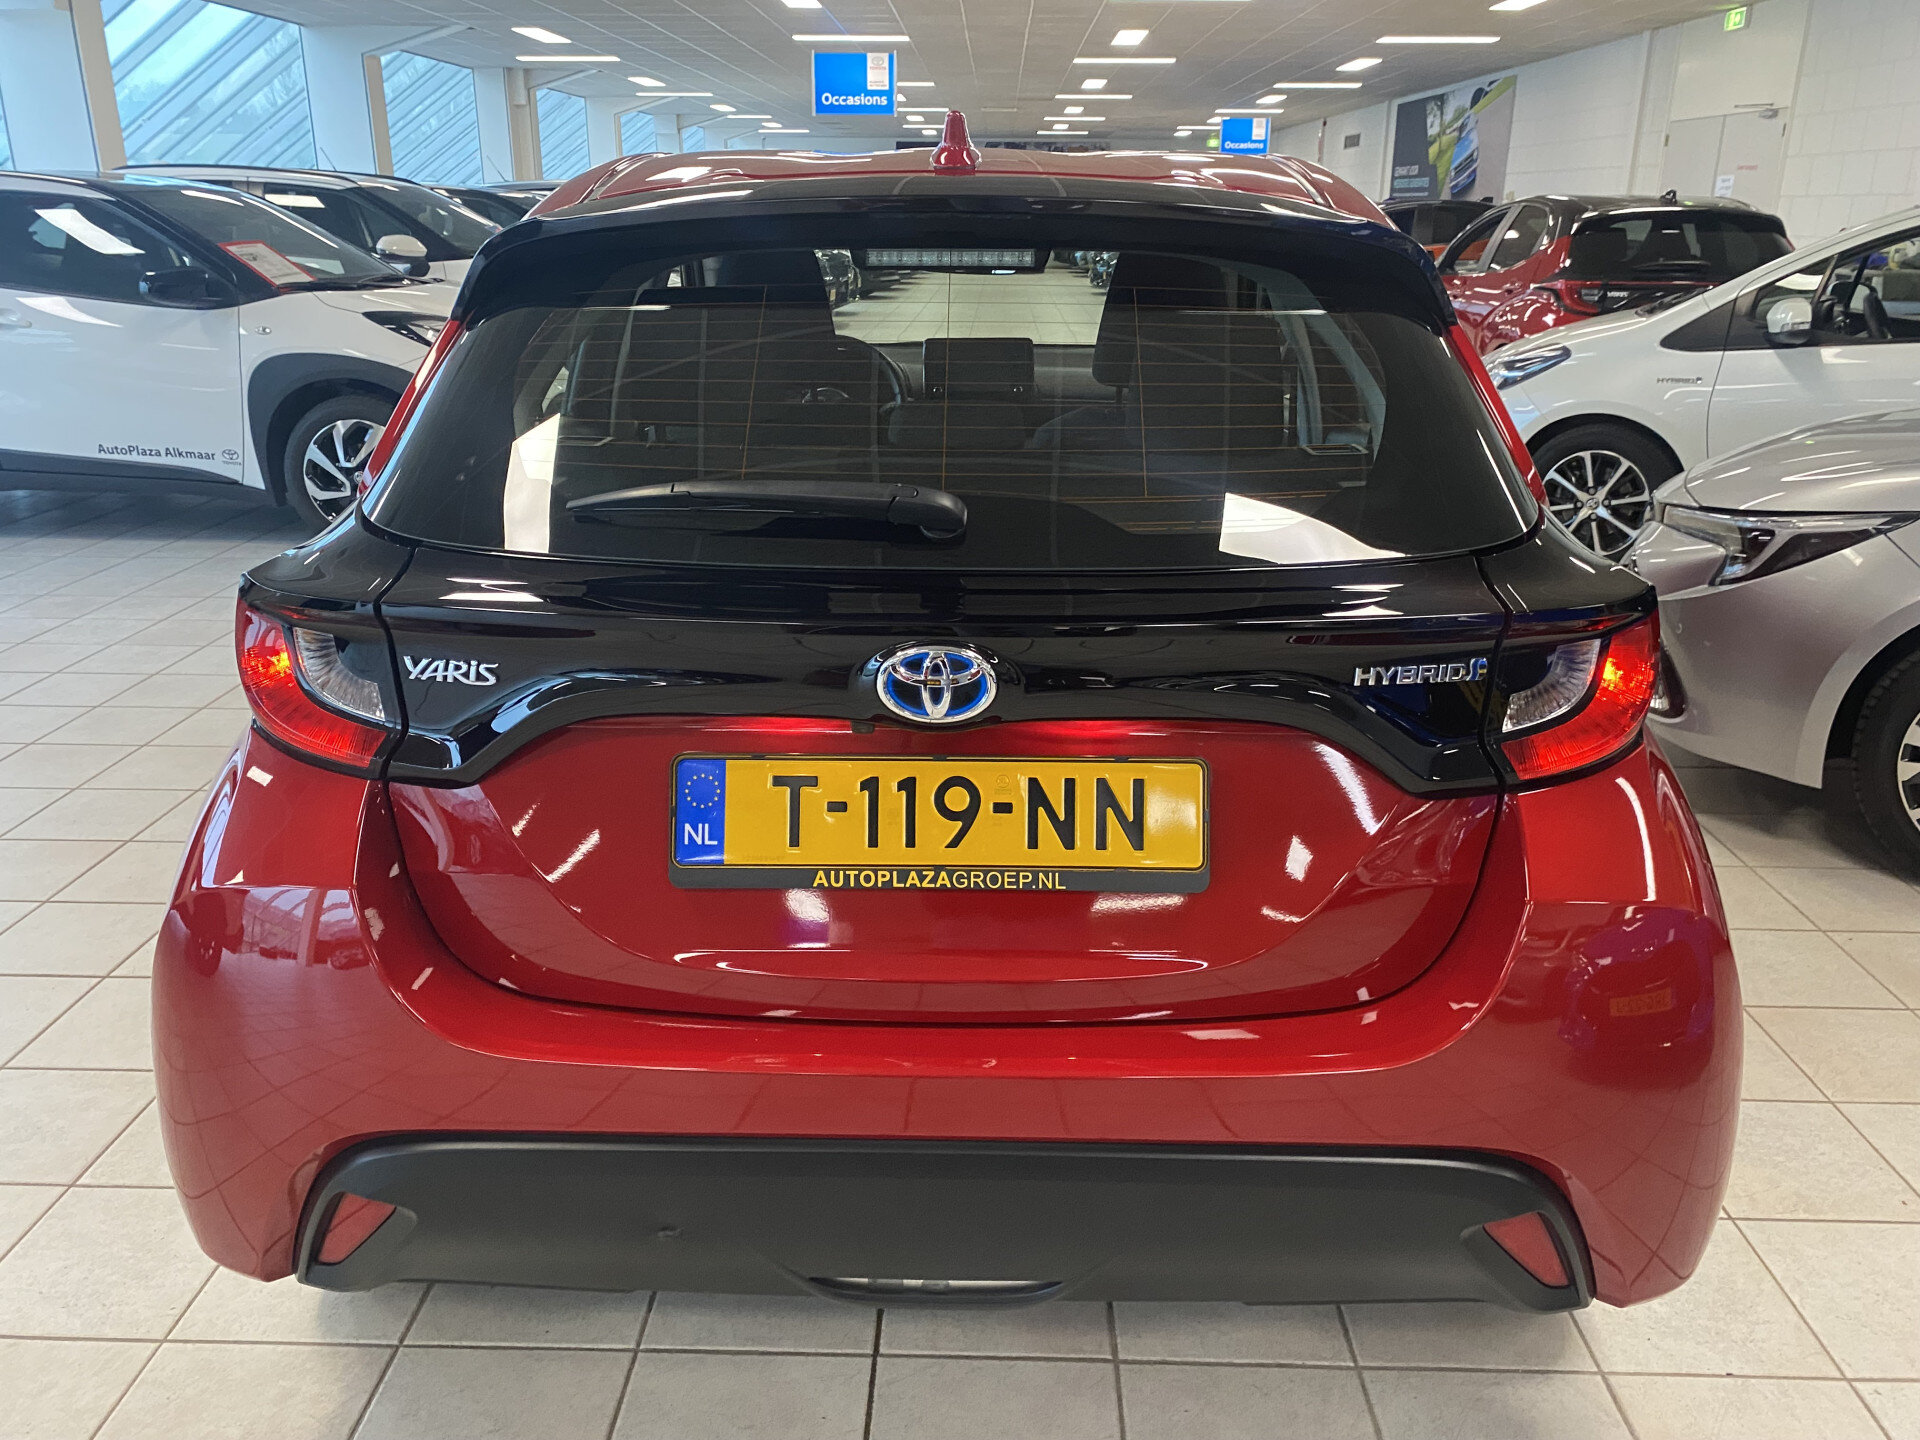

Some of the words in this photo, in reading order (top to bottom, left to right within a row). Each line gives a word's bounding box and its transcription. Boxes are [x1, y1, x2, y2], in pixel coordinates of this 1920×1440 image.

[821, 92, 888, 106] Occasions
[1224, 140, 1264, 150] Occasions
[98, 443, 162, 457] AutoPlaza
[165, 446, 215, 461] Alkmaar
[771, 774, 1146, 852] T-119-NN
[683, 823, 719, 846] NL
[812, 870, 1067, 890] AUTOPLAZAGROEP.NL
